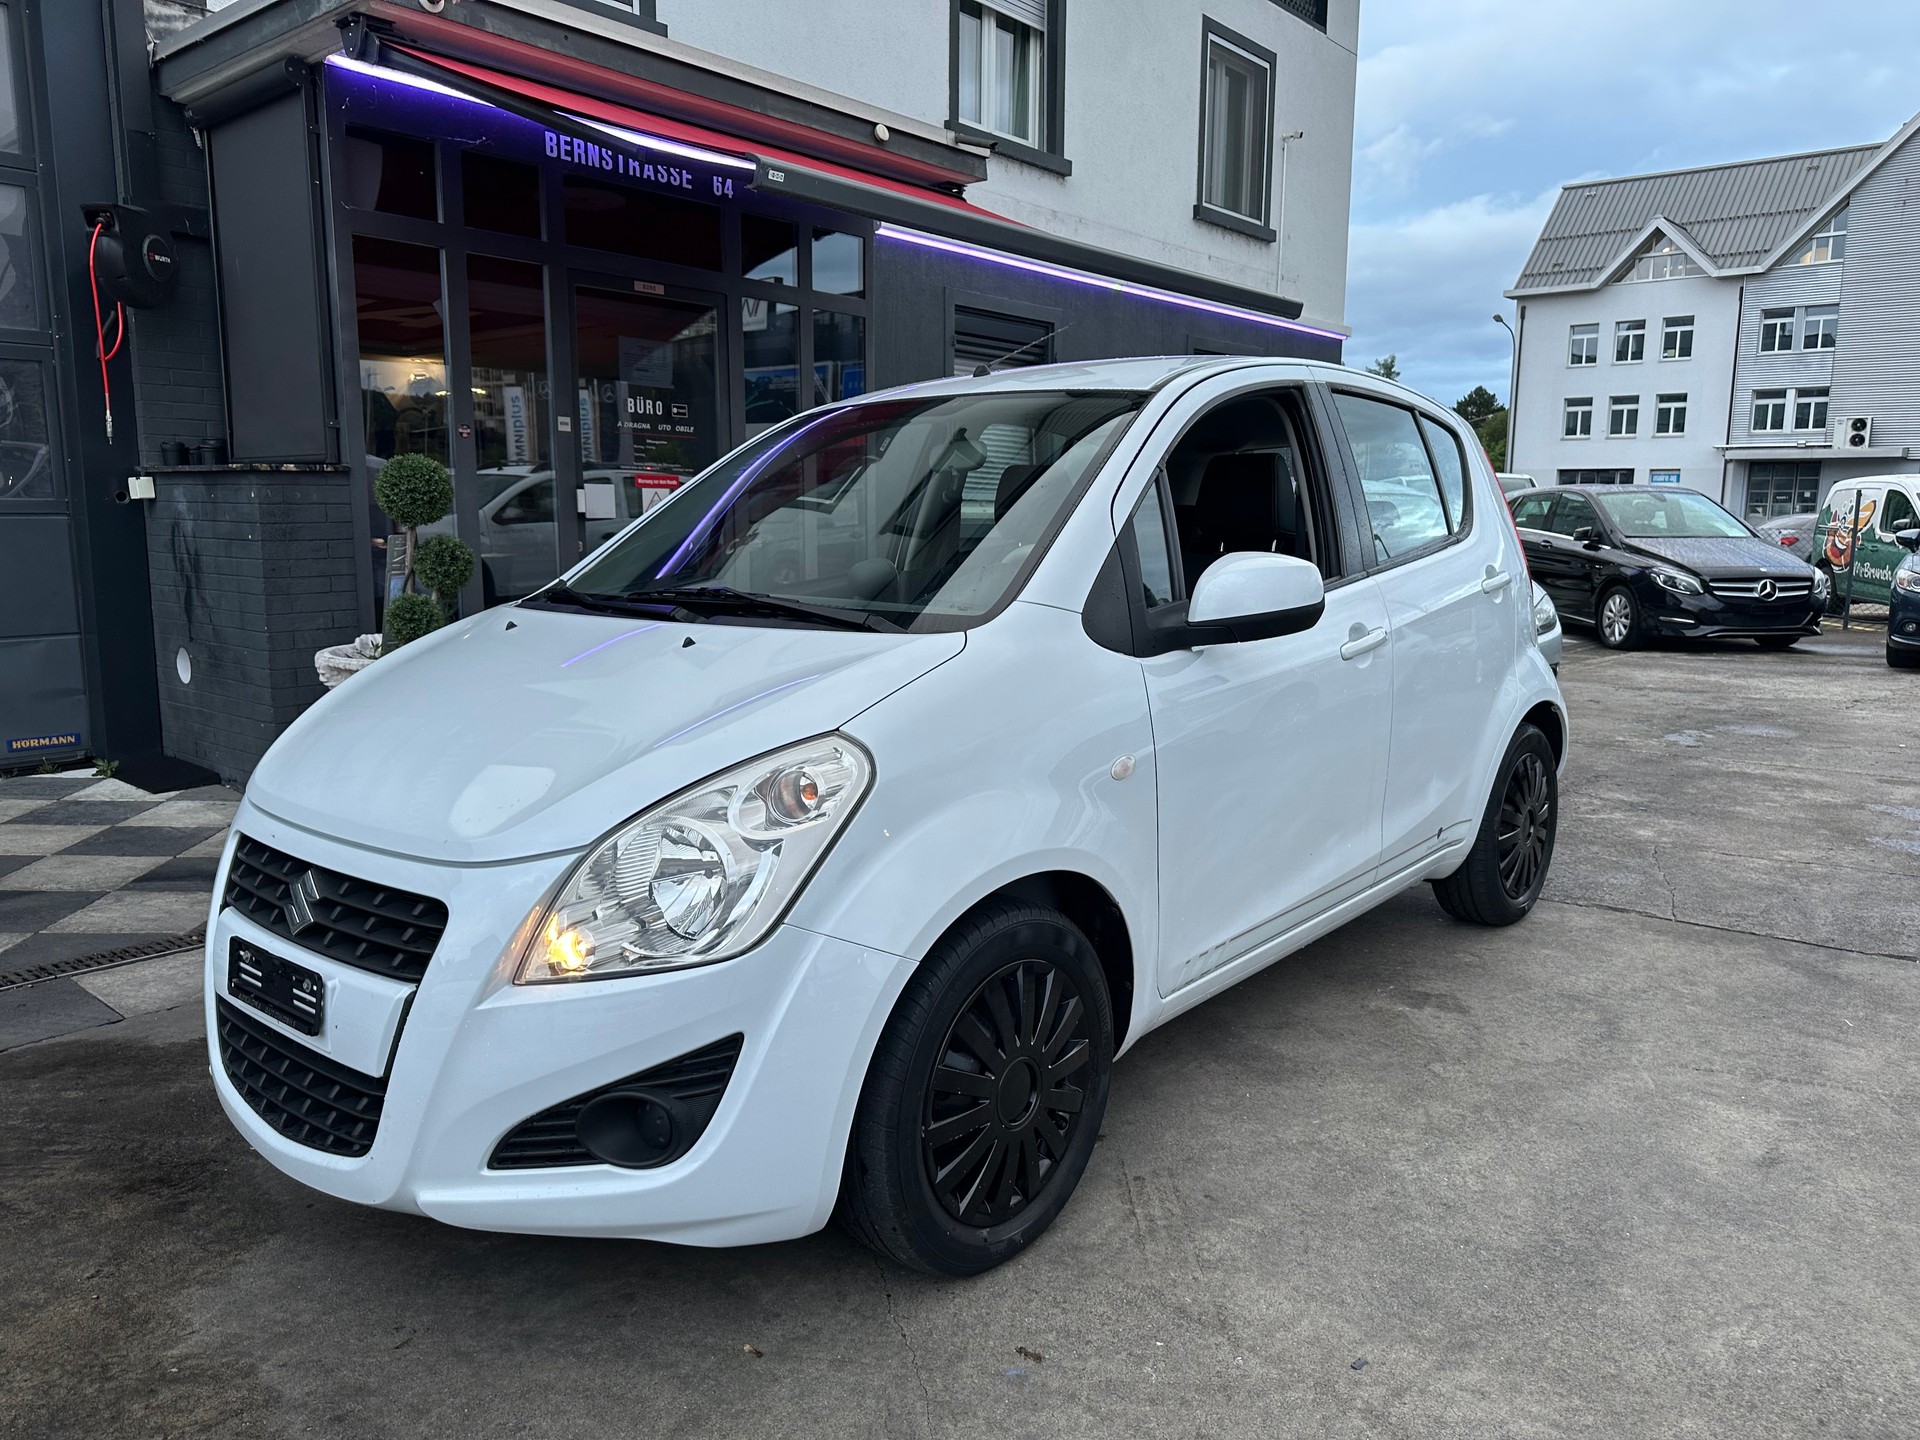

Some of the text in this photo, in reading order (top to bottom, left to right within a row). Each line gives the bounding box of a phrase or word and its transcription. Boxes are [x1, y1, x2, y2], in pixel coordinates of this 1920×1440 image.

[544, 130, 733, 198] BERNSTRASSE 64
[627, 396, 663, 415] BÜRO
[12, 735, 76, 749] HÖRMANN
